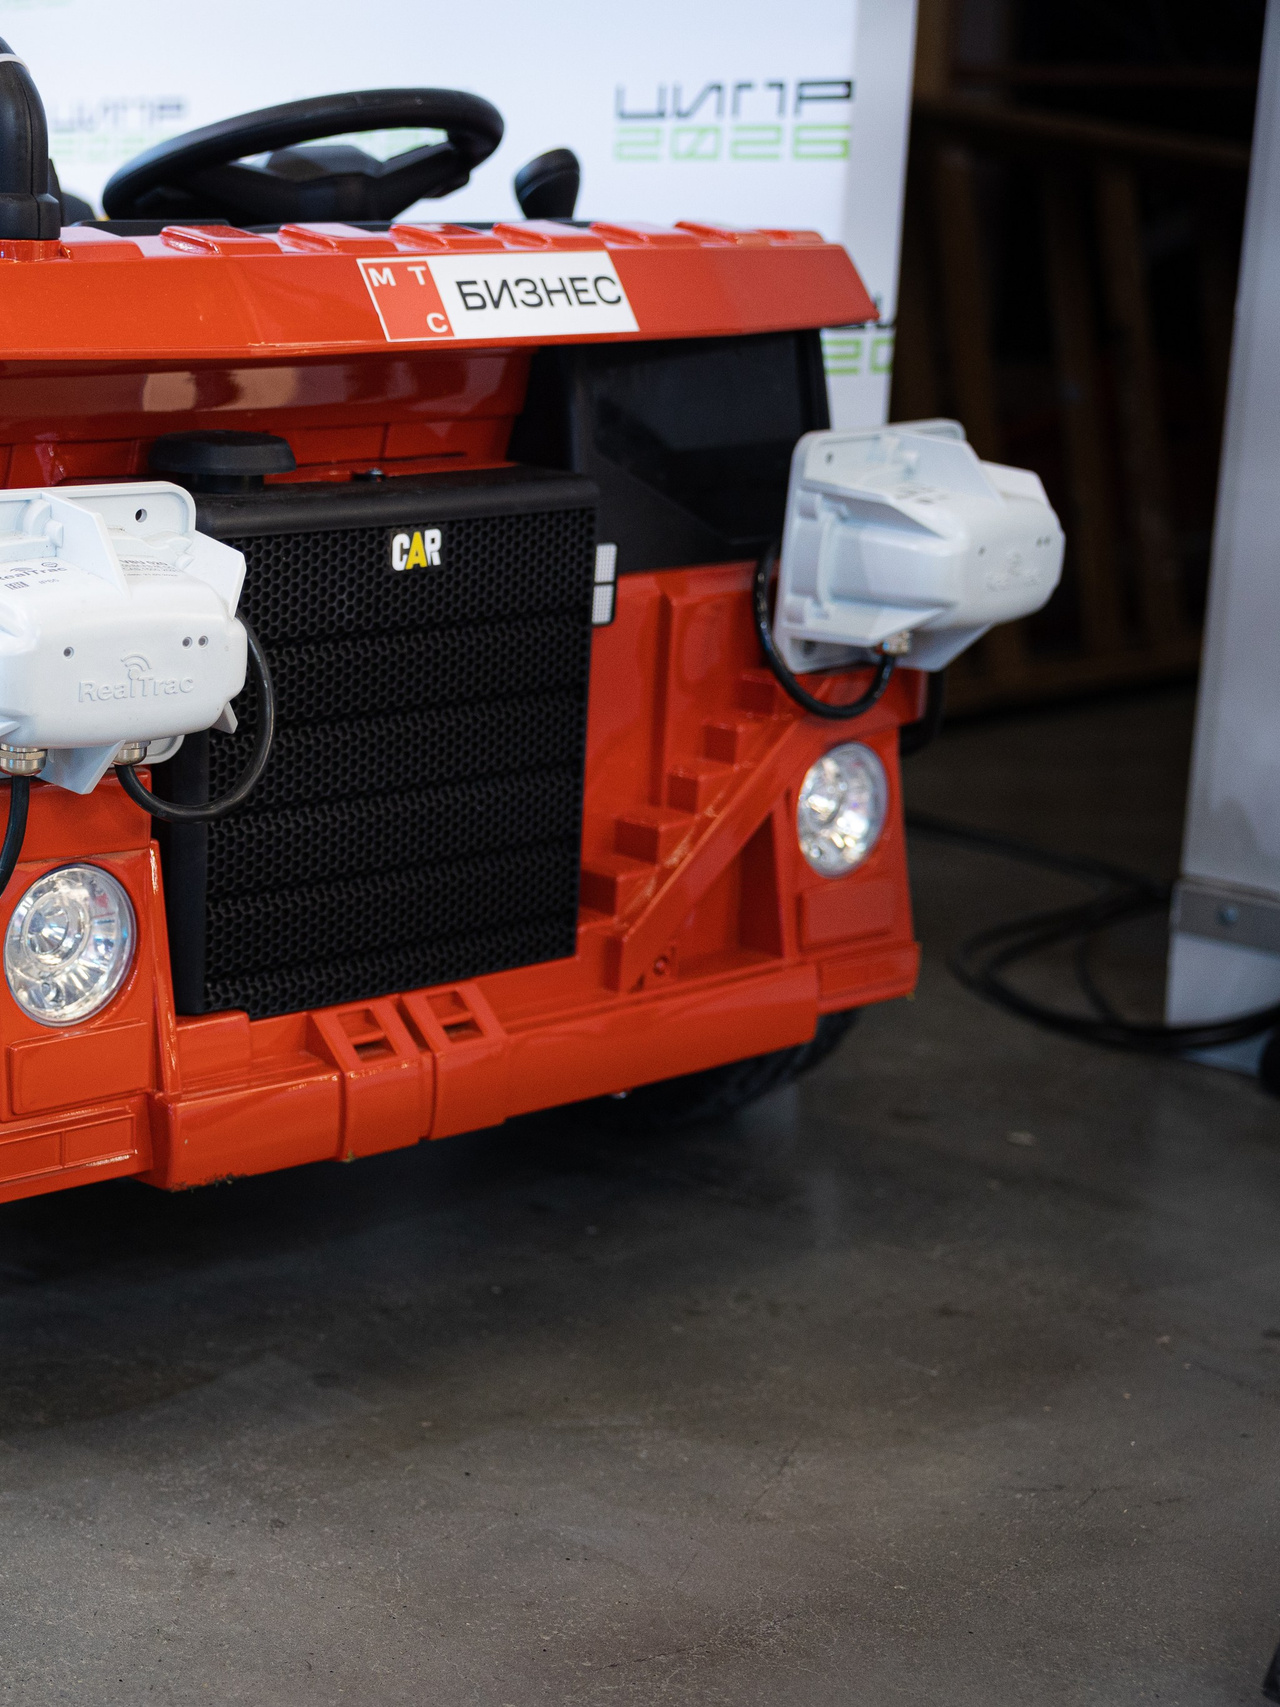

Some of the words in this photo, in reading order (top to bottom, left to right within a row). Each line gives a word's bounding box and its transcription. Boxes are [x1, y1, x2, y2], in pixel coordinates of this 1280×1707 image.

[613, 125, 851, 162] 2026
[455, 275, 622, 311] БИЗНЕС
[391, 528, 442, 572] CAR
[78, 672, 195, 703] RealTrac
